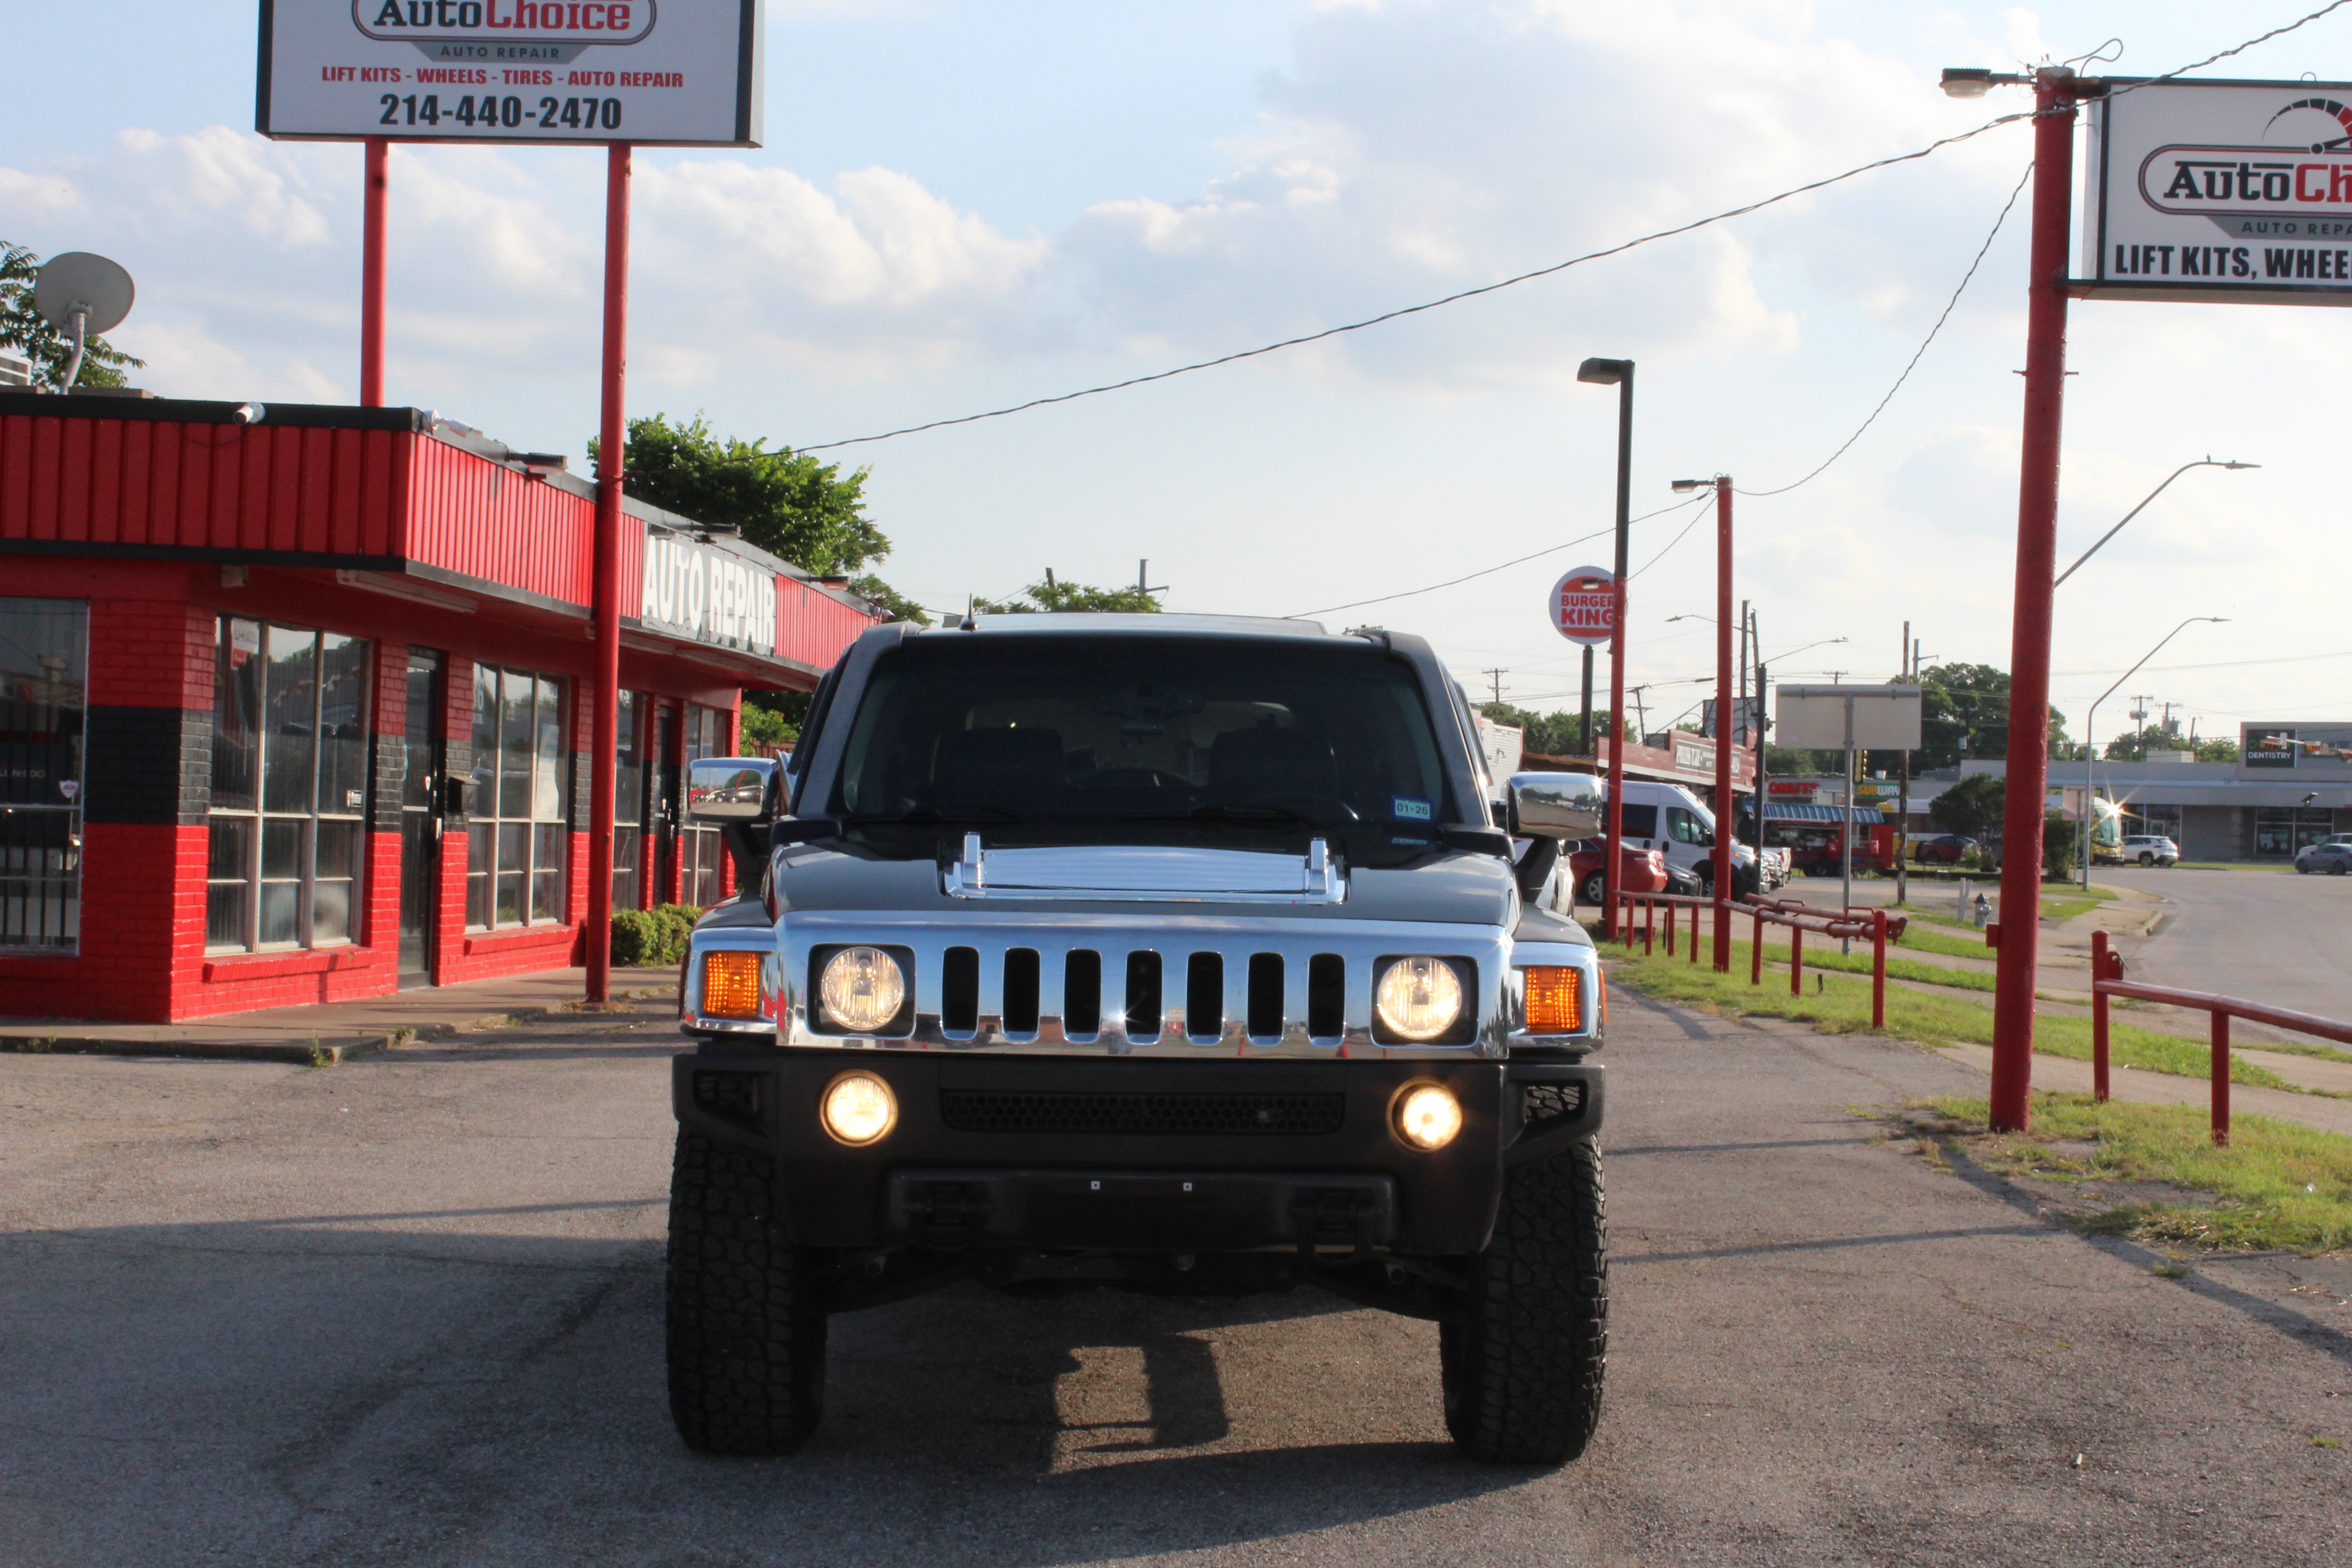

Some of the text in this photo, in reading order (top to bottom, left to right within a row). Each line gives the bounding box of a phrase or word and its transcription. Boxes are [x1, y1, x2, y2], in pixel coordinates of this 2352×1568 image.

[373, 0, 631, 30] AutoChoice
[441, 47, 559, 59] AUTO REPAIR
[322, 67, 357, 81] LIFT
[361, 68, 402, 83] KITS
[416, 68, 487, 84] WHEELS
[502, 69, 553, 85] TIRES
[568, 71, 615, 86] AUTO
[620, 72, 683, 88] REPAIR
[380, 93, 622, 130] 214-440-2470
[2241, 221, 2297, 234] AUTO
[2116, 244, 2352, 280] LIFT KITS, WHEE
[641, 534, 776, 647] AUTO REPAIR
[1561, 595, 1615, 607] BURGER
[1561, 608, 1615, 626] KING
[1768, 781, 1819, 794] ONUTS
